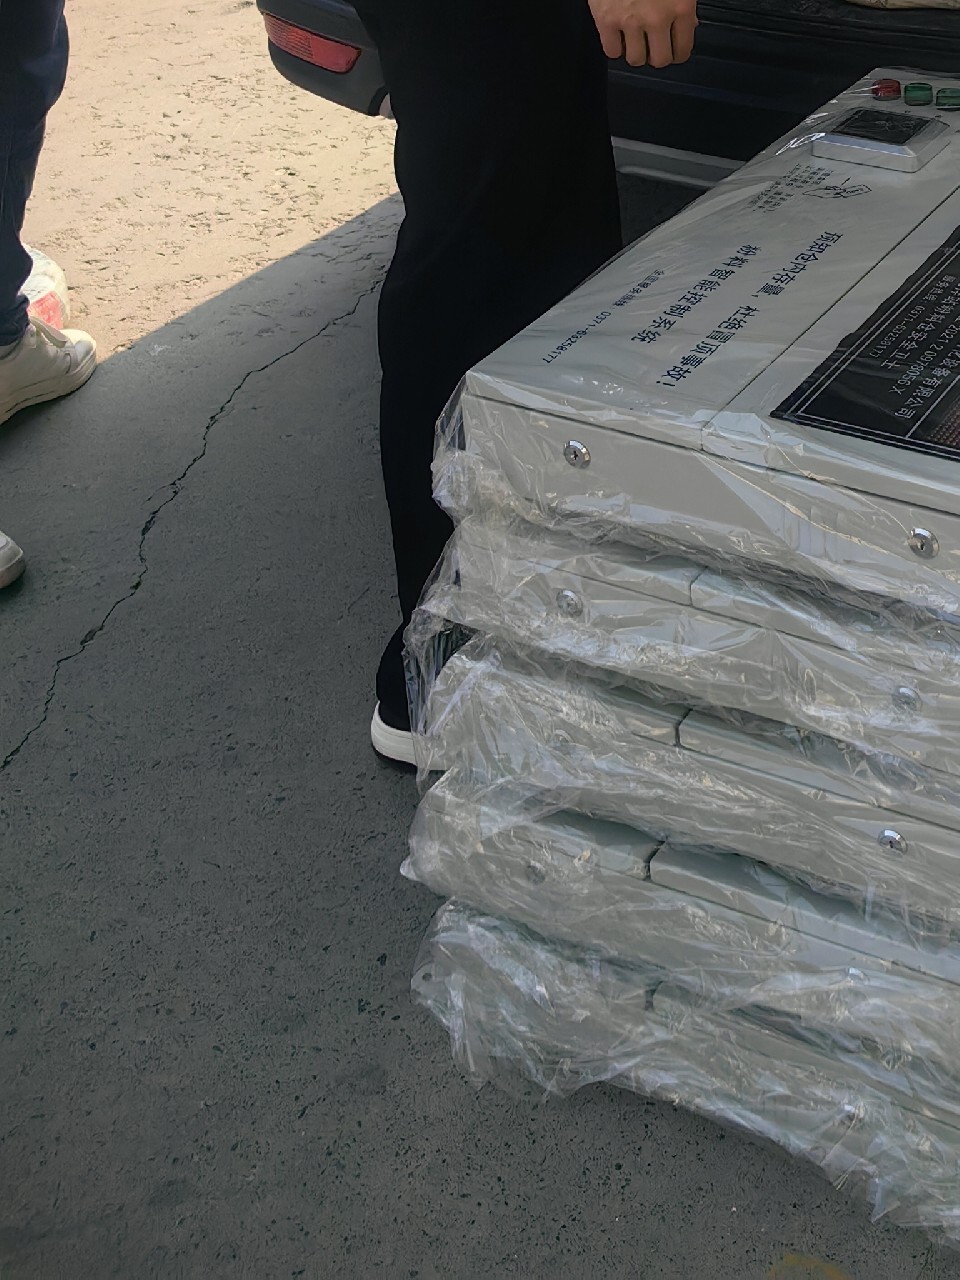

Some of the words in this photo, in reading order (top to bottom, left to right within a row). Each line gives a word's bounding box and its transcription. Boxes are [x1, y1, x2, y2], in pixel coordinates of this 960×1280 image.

[628, 244, 764, 345] 粉料智能控制系统
